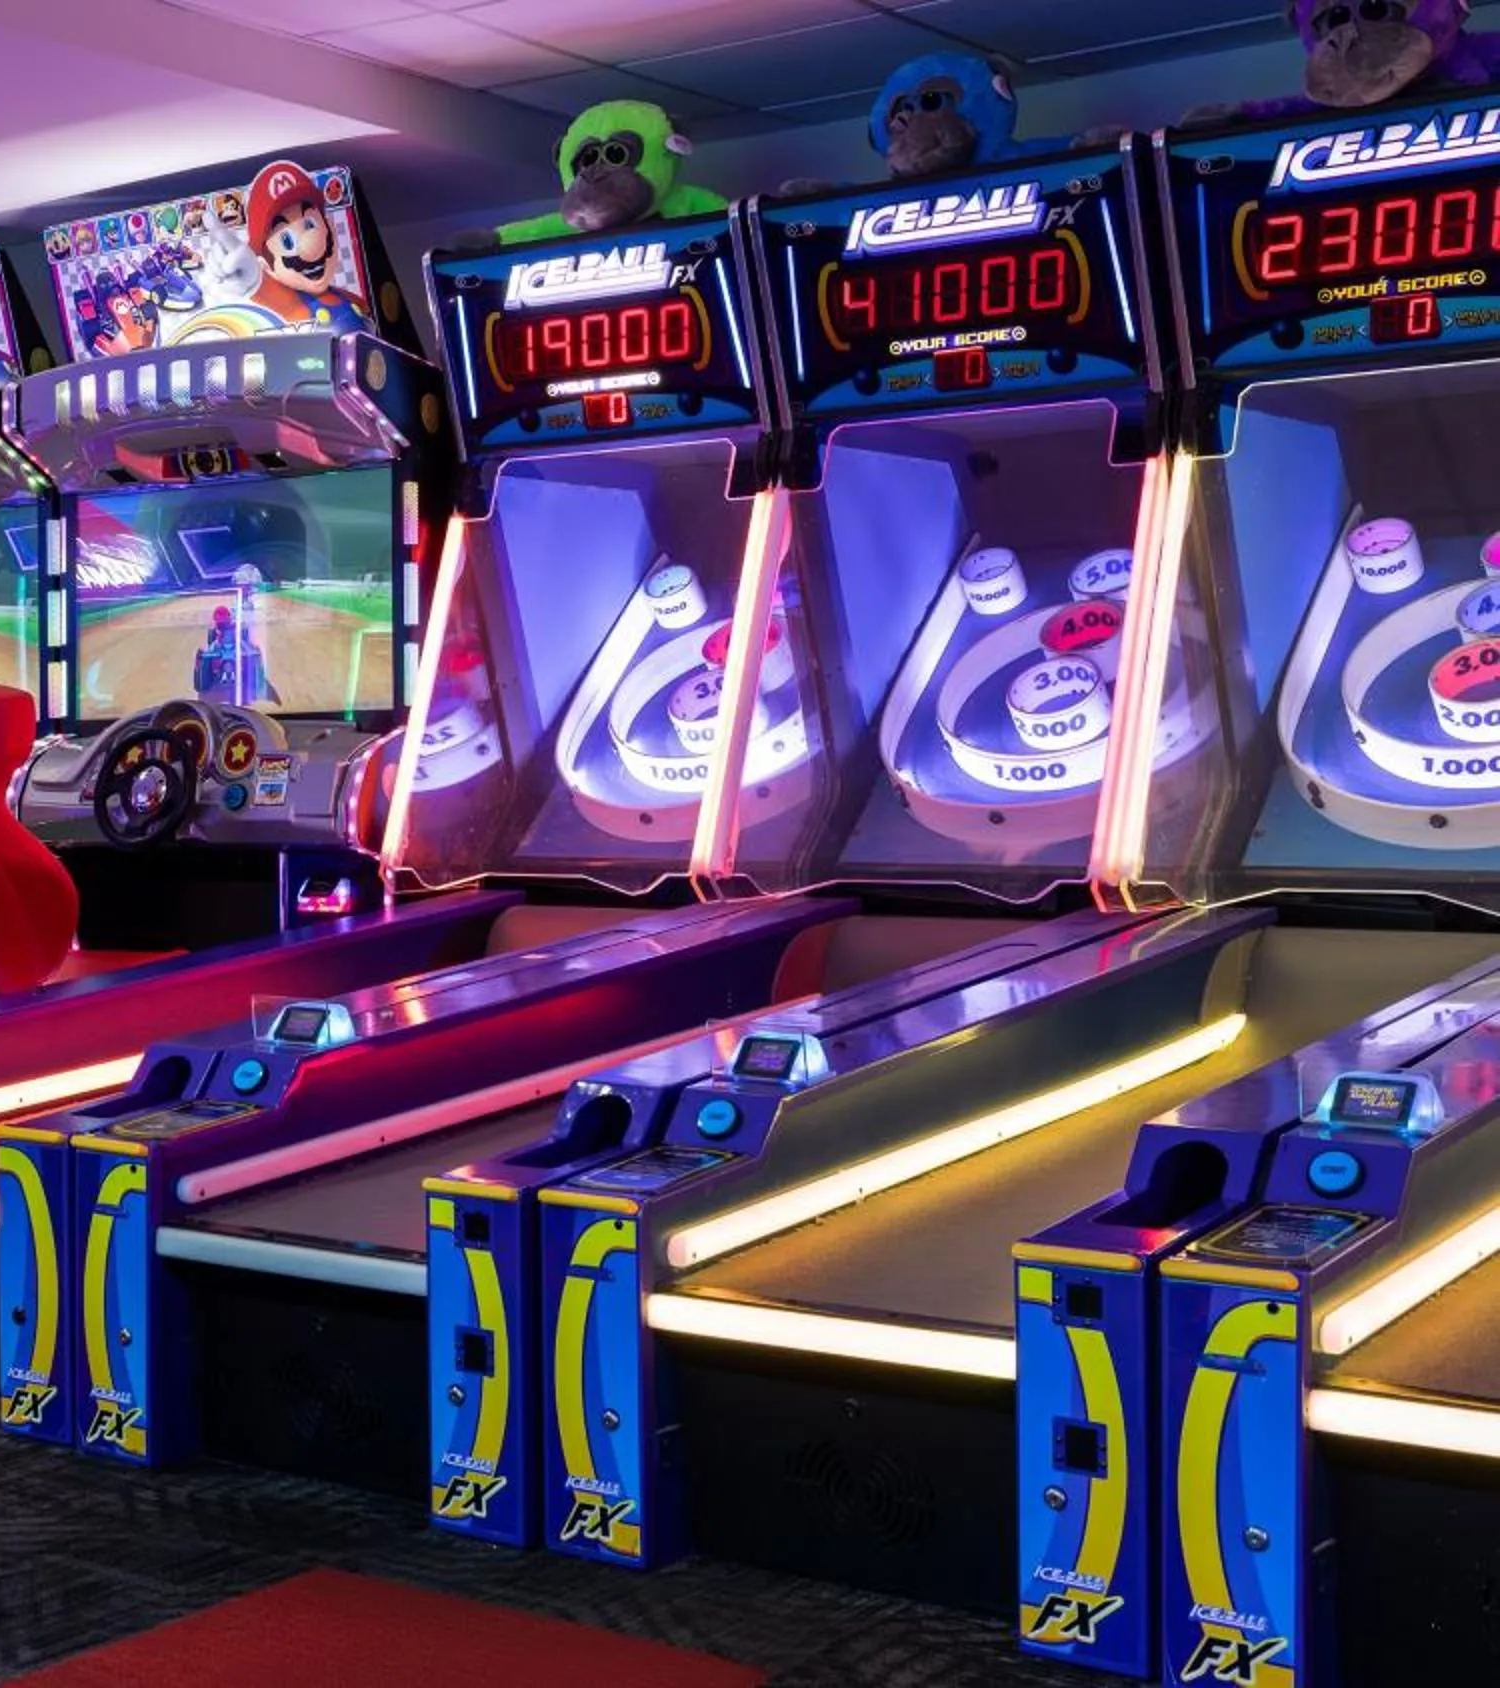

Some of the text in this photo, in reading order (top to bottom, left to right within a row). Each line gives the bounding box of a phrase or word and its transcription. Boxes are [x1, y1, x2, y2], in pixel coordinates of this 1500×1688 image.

[1043, 198, 1086, 232] FX
[1262, 187, 1500, 280] 2300
[669, 258, 704, 288] FX
[843, 250, 1065, 329] 41000
[1333, 273, 1468, 300] YOUR SCORE
[1407, 297, 1433, 336] 0
[526, 303, 690, 373] 19000
[608, 391, 627, 424] 0
[5, 1386, 57, 1424] FX
[86, 1407, 142, 1443] FX
[438, 1475, 507, 1518] FX
[560, 1499, 633, 1543] FX
[1027, 1594, 1125, 1644] FX
[1181, 1636, 1288, 1686] FX
